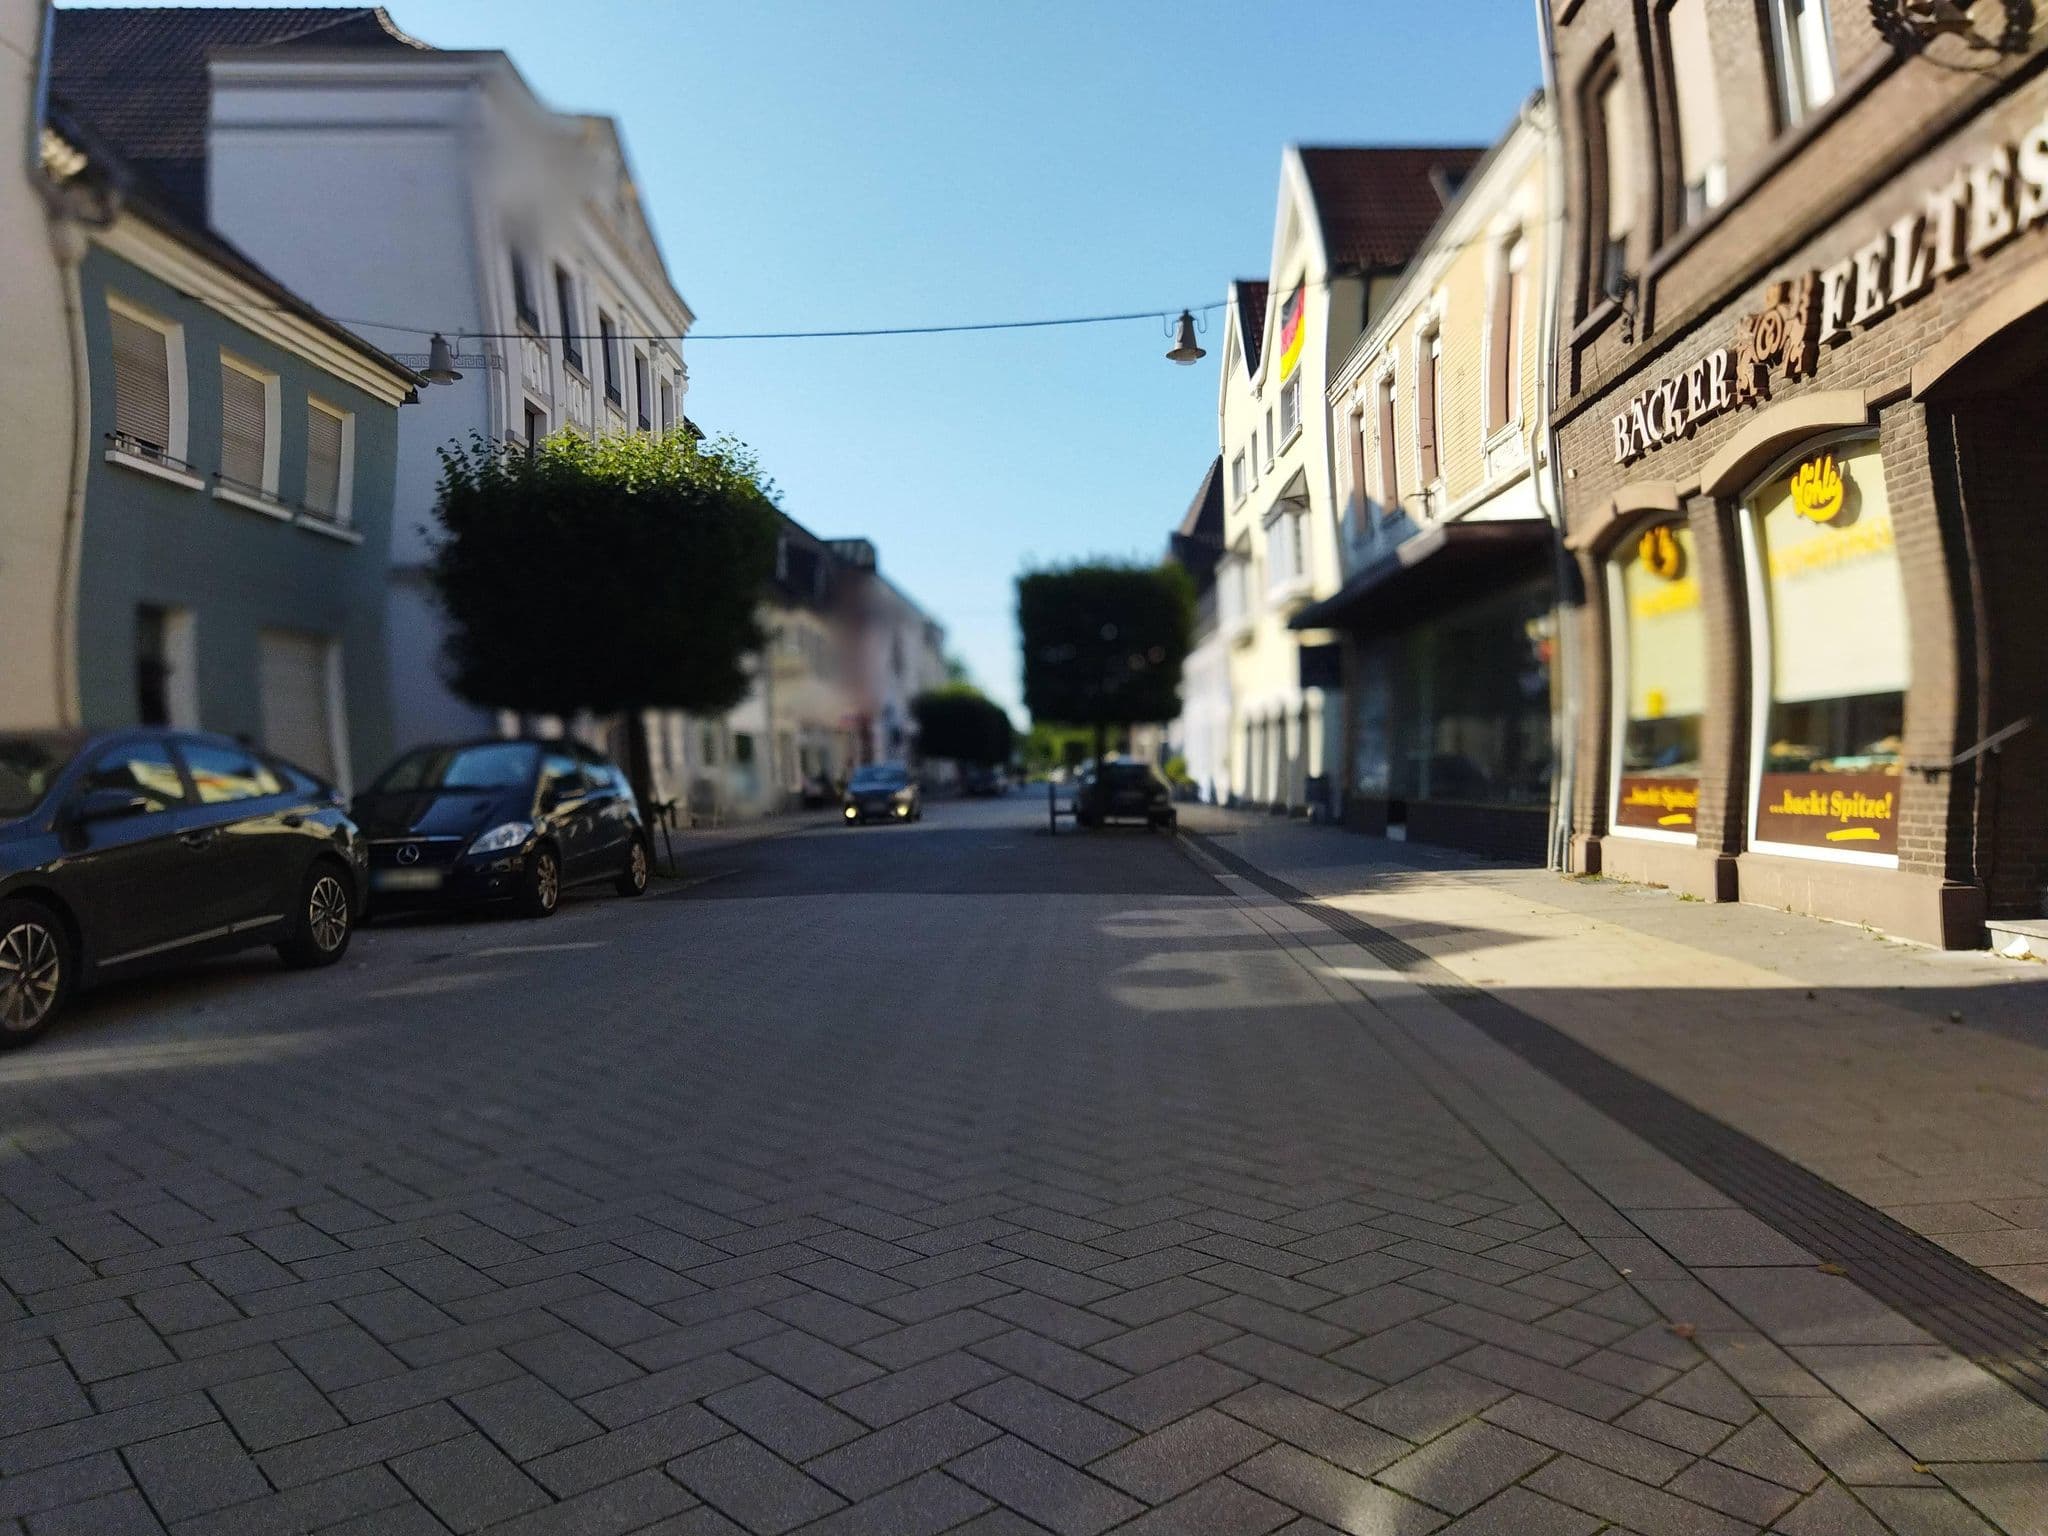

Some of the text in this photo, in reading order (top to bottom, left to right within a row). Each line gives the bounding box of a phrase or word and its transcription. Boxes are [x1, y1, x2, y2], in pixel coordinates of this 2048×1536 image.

[1611, 103, 2048, 464] BÄCKER FELTES
[1830, 790, 1893, 823] Spitze!
